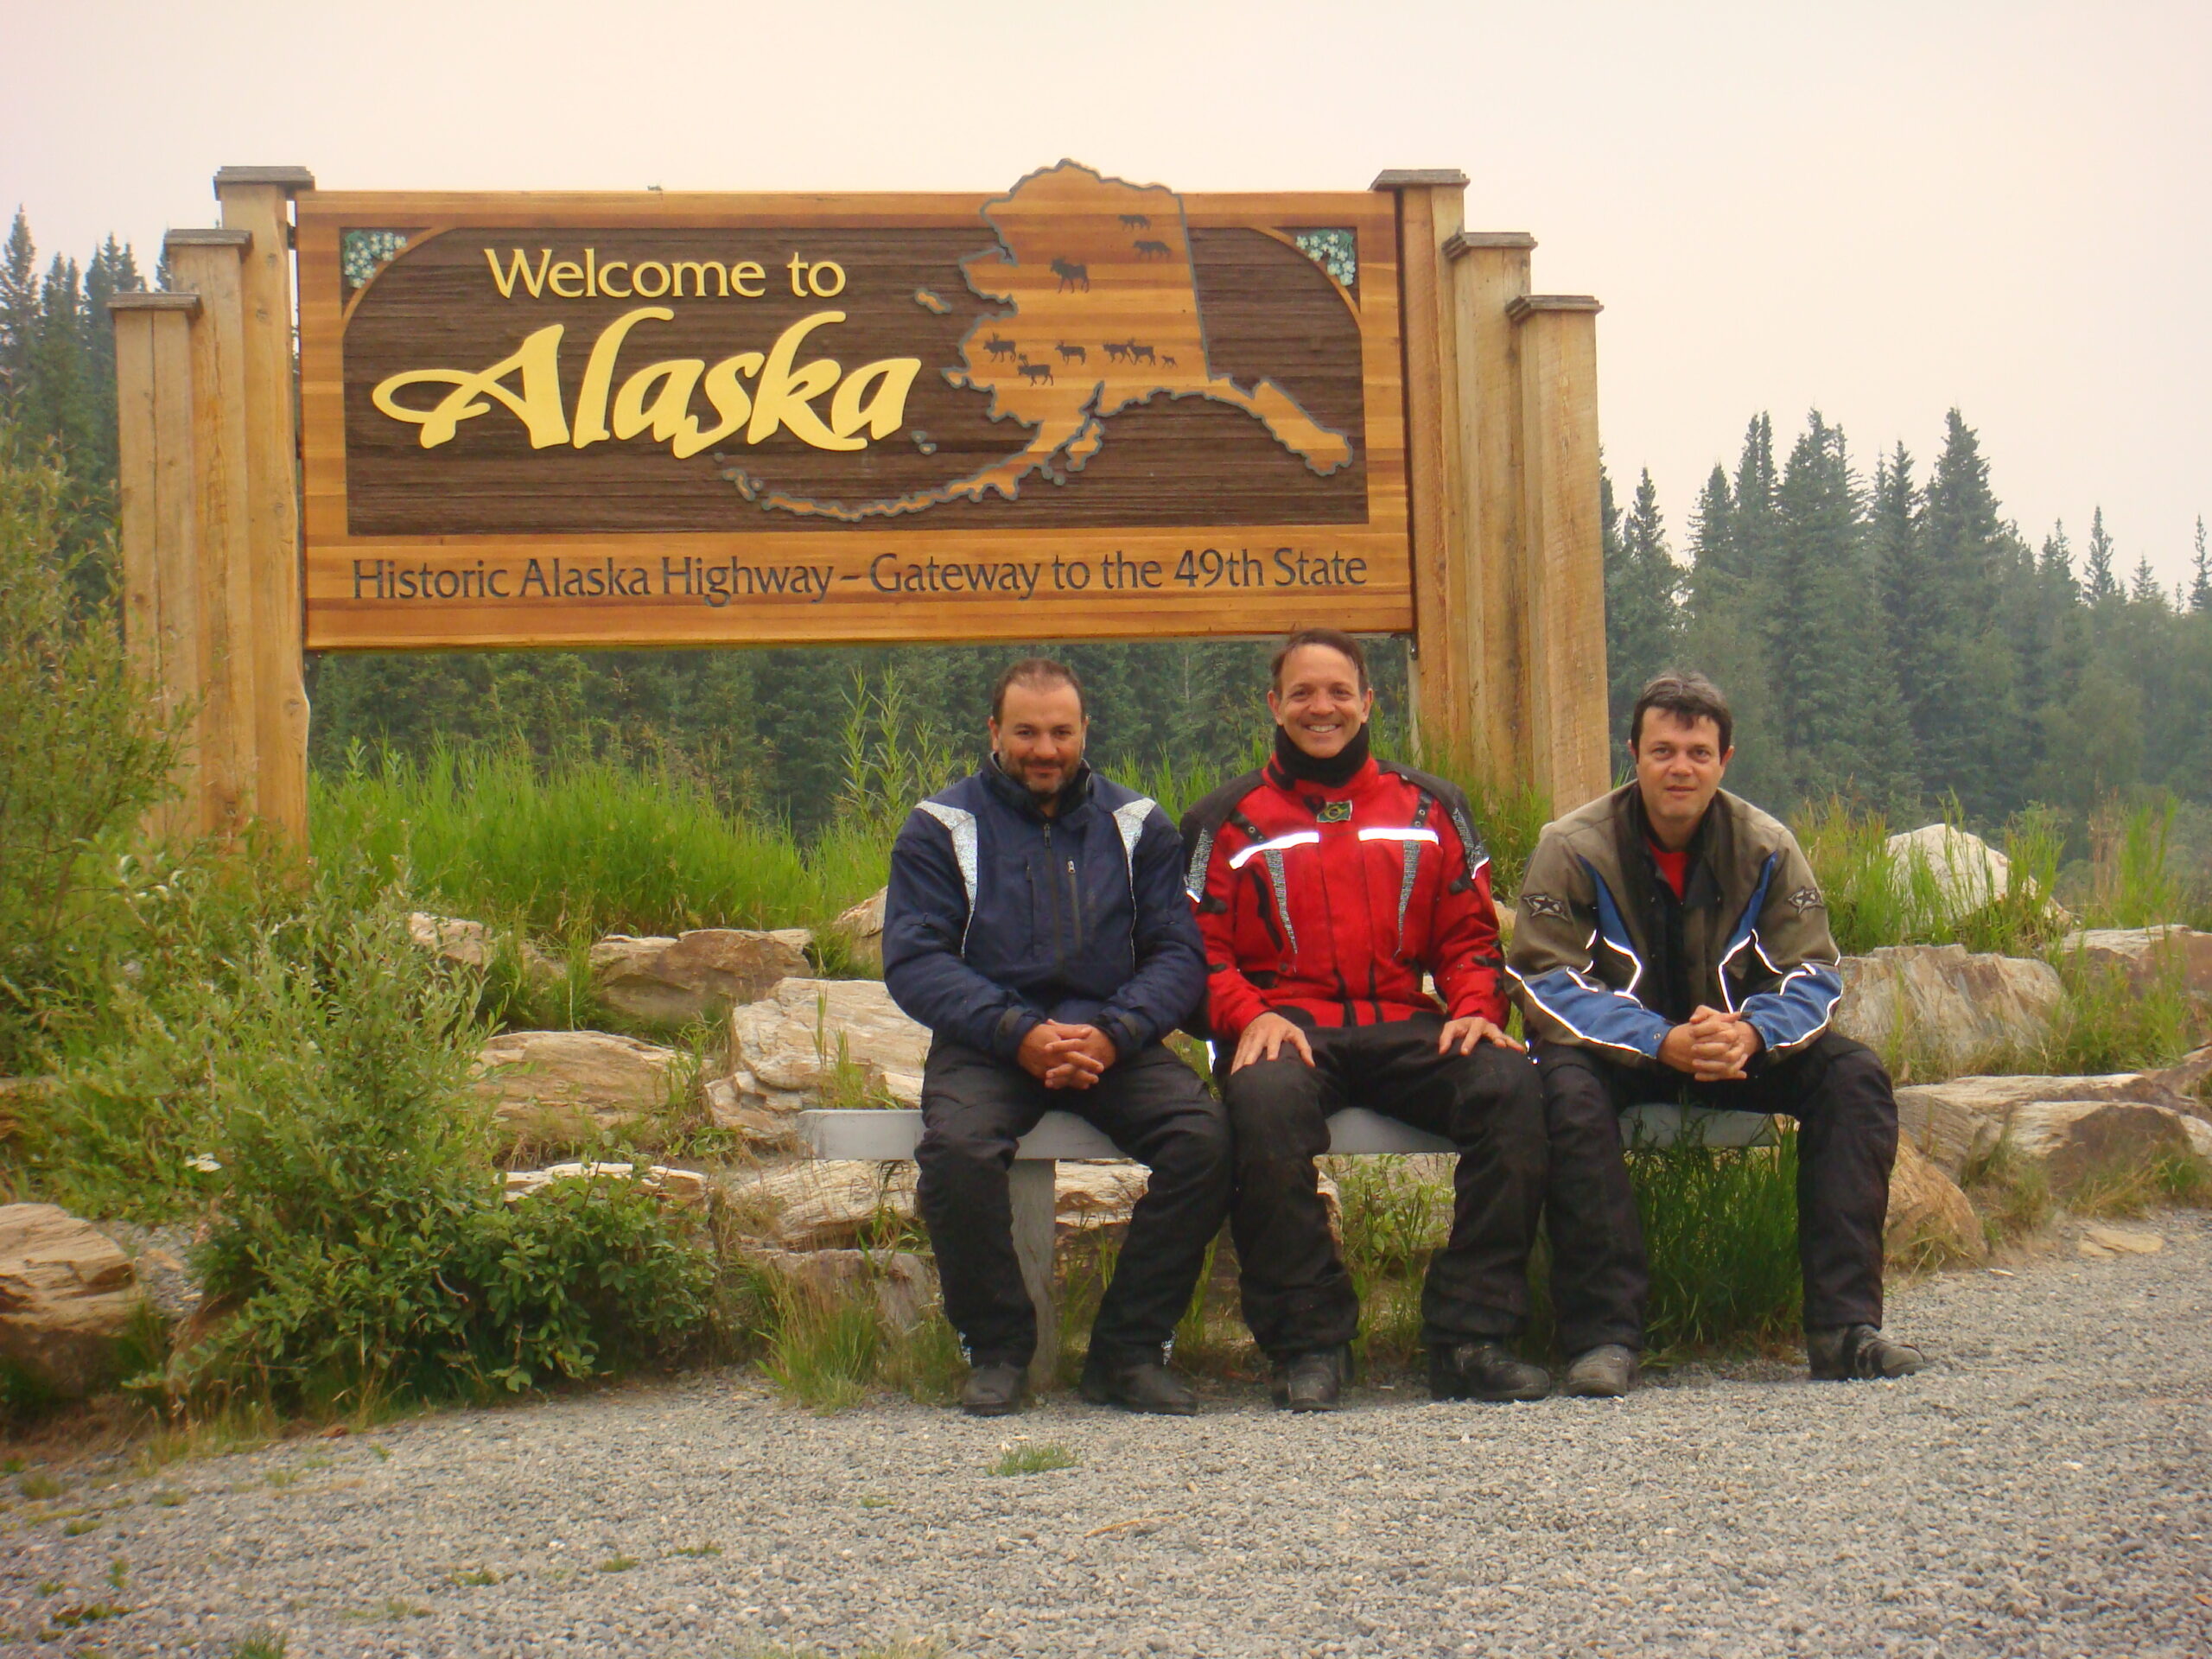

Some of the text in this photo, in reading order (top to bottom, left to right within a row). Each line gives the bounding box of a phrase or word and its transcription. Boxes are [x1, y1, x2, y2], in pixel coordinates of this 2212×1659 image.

[484, 247, 847, 299] Welcome to
[372, 307, 922, 459] Alaska
[353, 559, 510, 600] Historic
[518, 557, 652, 598] Alaska
[661, 556, 835, 607] Highway
[869, 551, 1040, 601] Gateway
[1052, 556, 1091, 591] to
[1101, 550, 1163, 589] the
[1173, 548, 1264, 588] 49th
[1272, 547, 1368, 586] State
